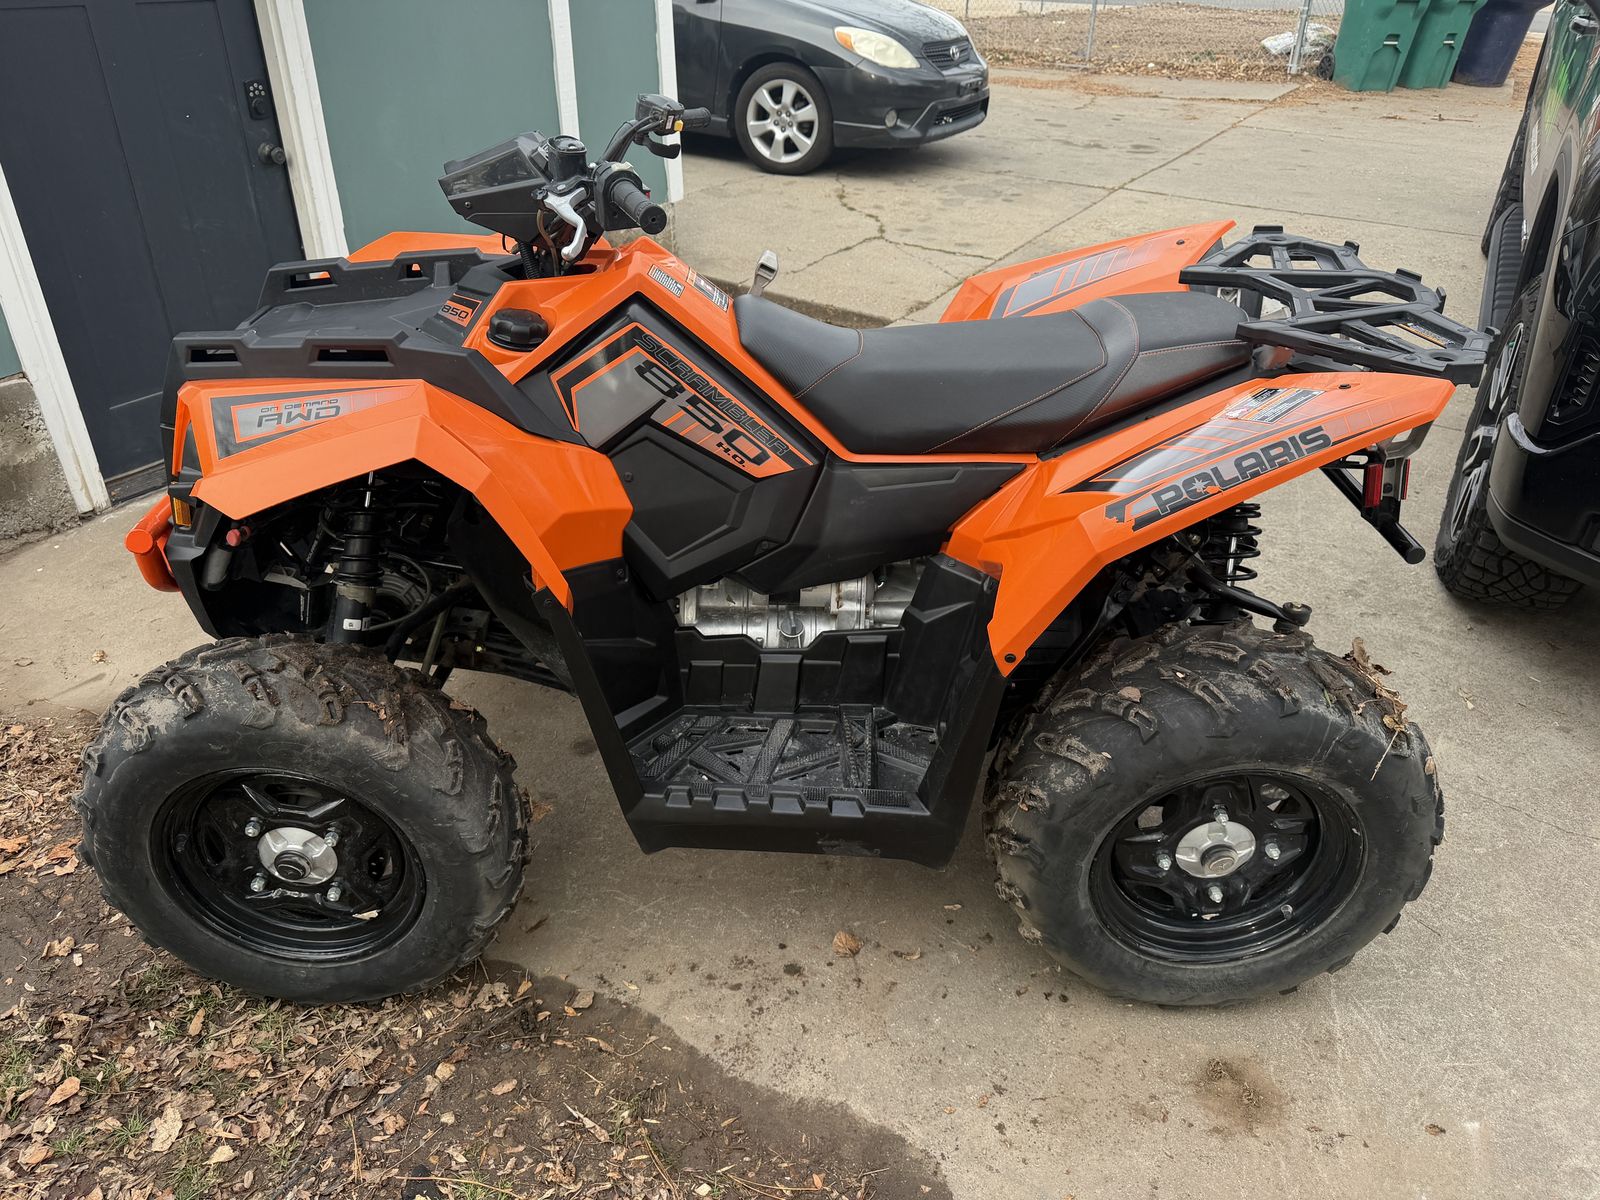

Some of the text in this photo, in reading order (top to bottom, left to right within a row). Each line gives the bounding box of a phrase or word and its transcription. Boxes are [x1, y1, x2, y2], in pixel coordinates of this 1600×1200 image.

[441, 304, 469, 319] 850
[257, 405, 341, 428] AWD
[634, 333, 790, 455] SCRAMBLER
[634, 359, 771, 466] 850
[715, 441, 746, 468] H.O.
[1151, 425, 1332, 516] POLARIS
